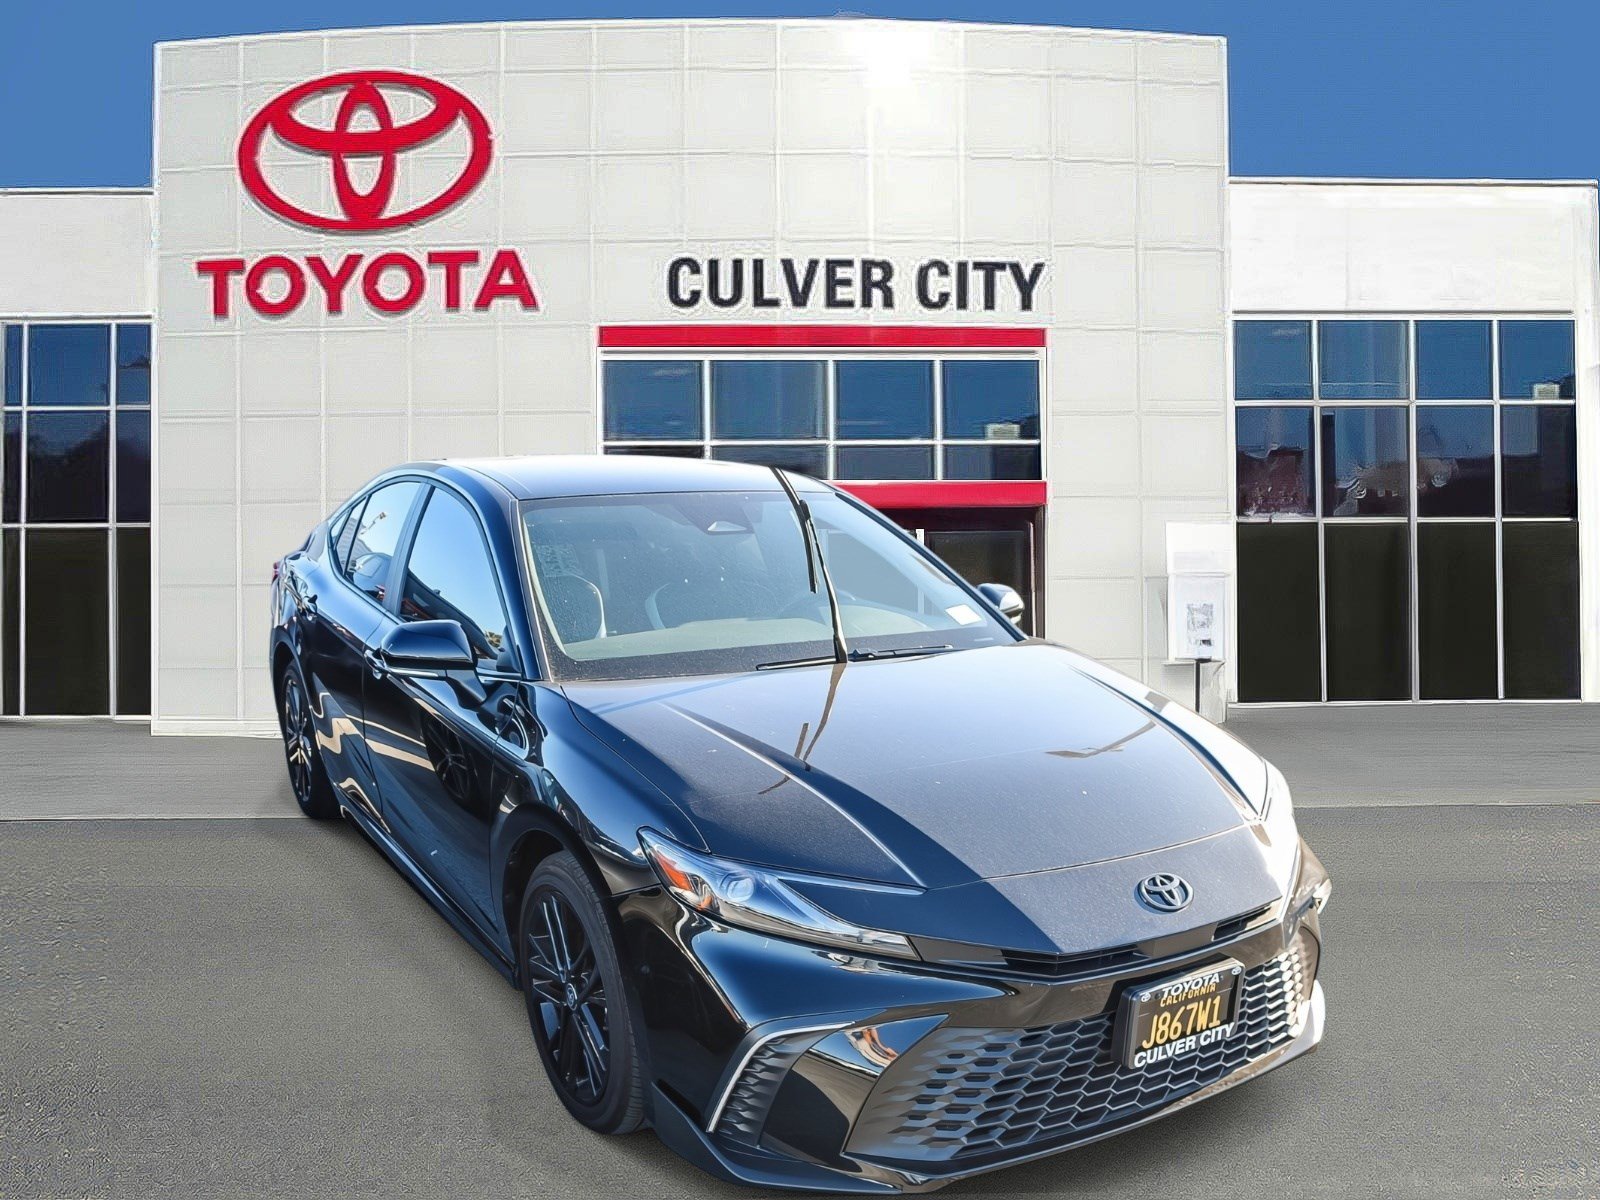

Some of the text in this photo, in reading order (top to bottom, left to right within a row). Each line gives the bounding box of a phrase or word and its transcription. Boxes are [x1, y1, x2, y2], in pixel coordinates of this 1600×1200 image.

[196, 250, 539, 317] TOYOTA
[667, 257, 1045, 311] CULVER CITY
[1160, 983, 1216, 1007] CALIFORNIA
[1162, 973, 1219, 999] TOYOTA
[1134, 1022, 1234, 1067] CULVER CITY
[1142, 996, 1220, 1048] J867W1
